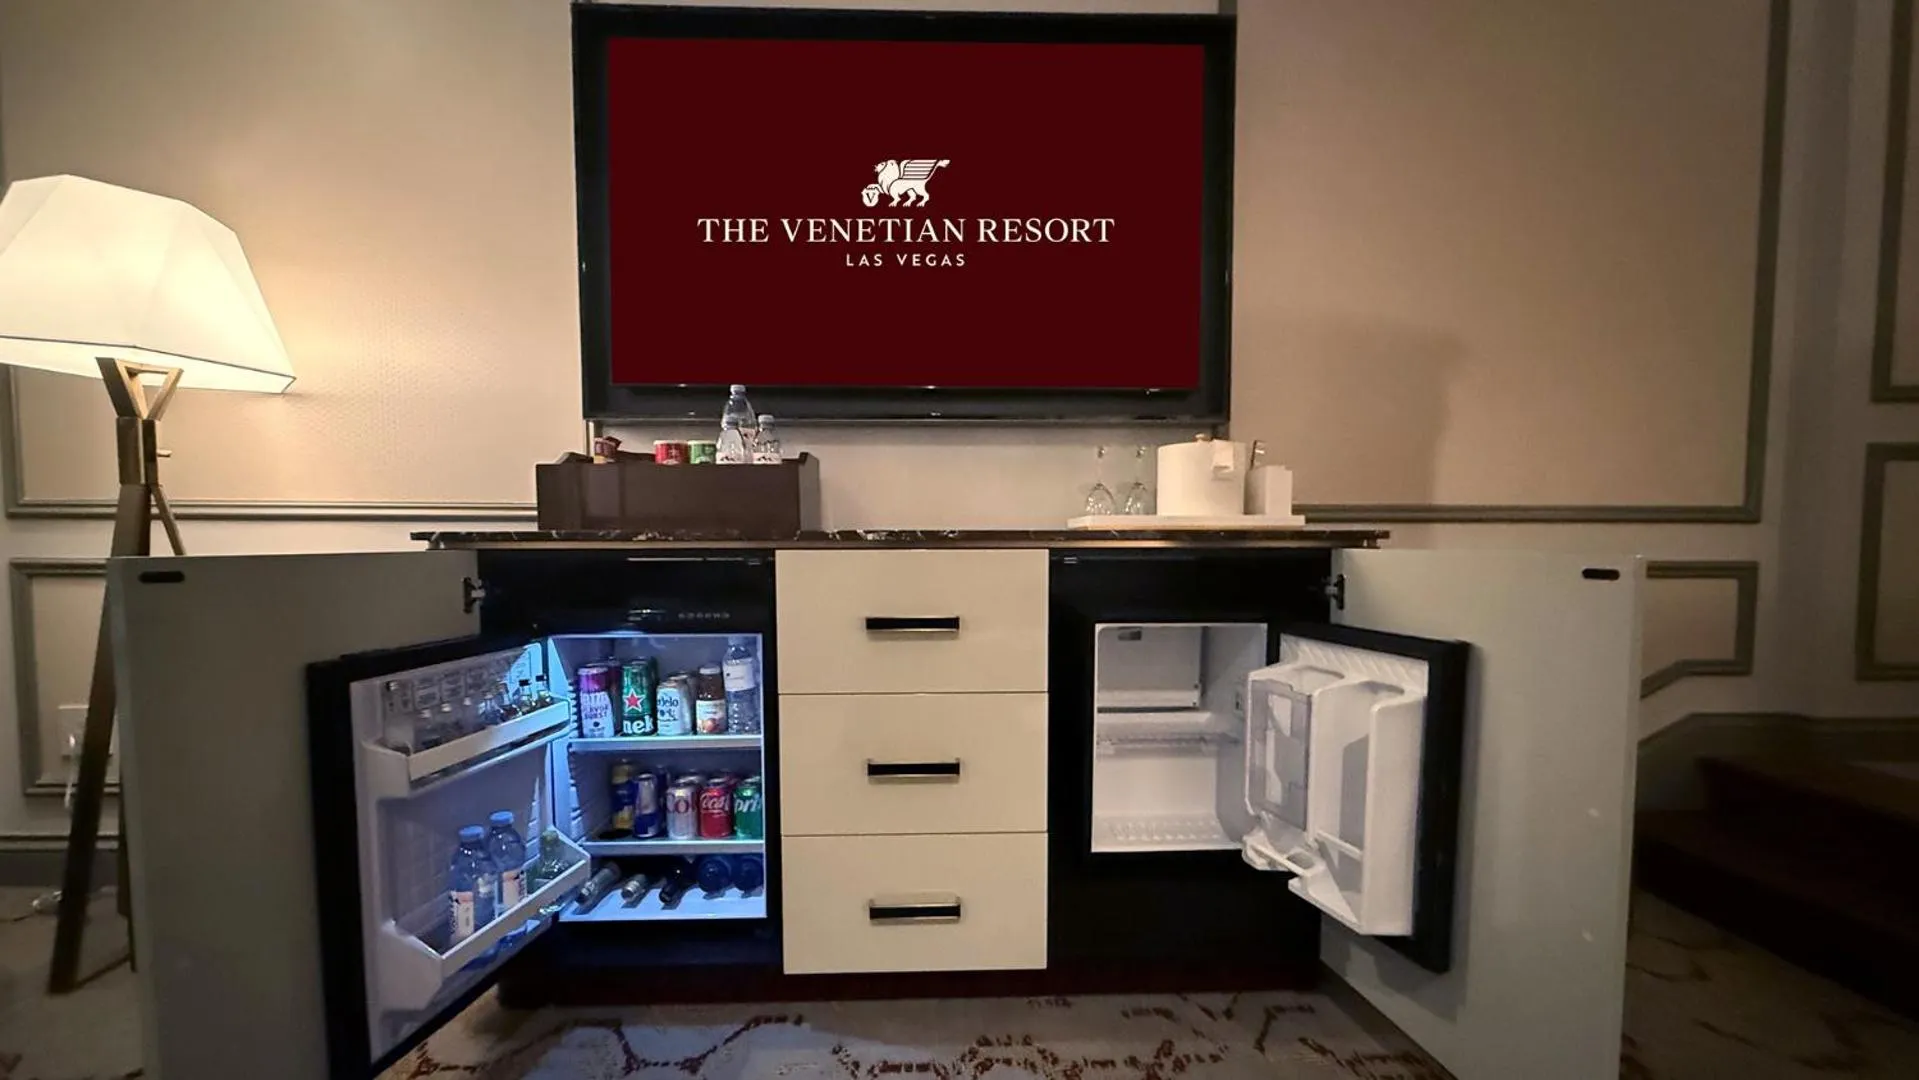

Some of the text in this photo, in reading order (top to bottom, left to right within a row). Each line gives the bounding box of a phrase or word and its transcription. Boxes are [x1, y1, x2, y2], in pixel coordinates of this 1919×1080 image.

[866, 192, 876, 204] V
[697, 218, 1115, 242] THE VENETIAN RESORT
[847, 253, 966, 267] LAS VEGAS
